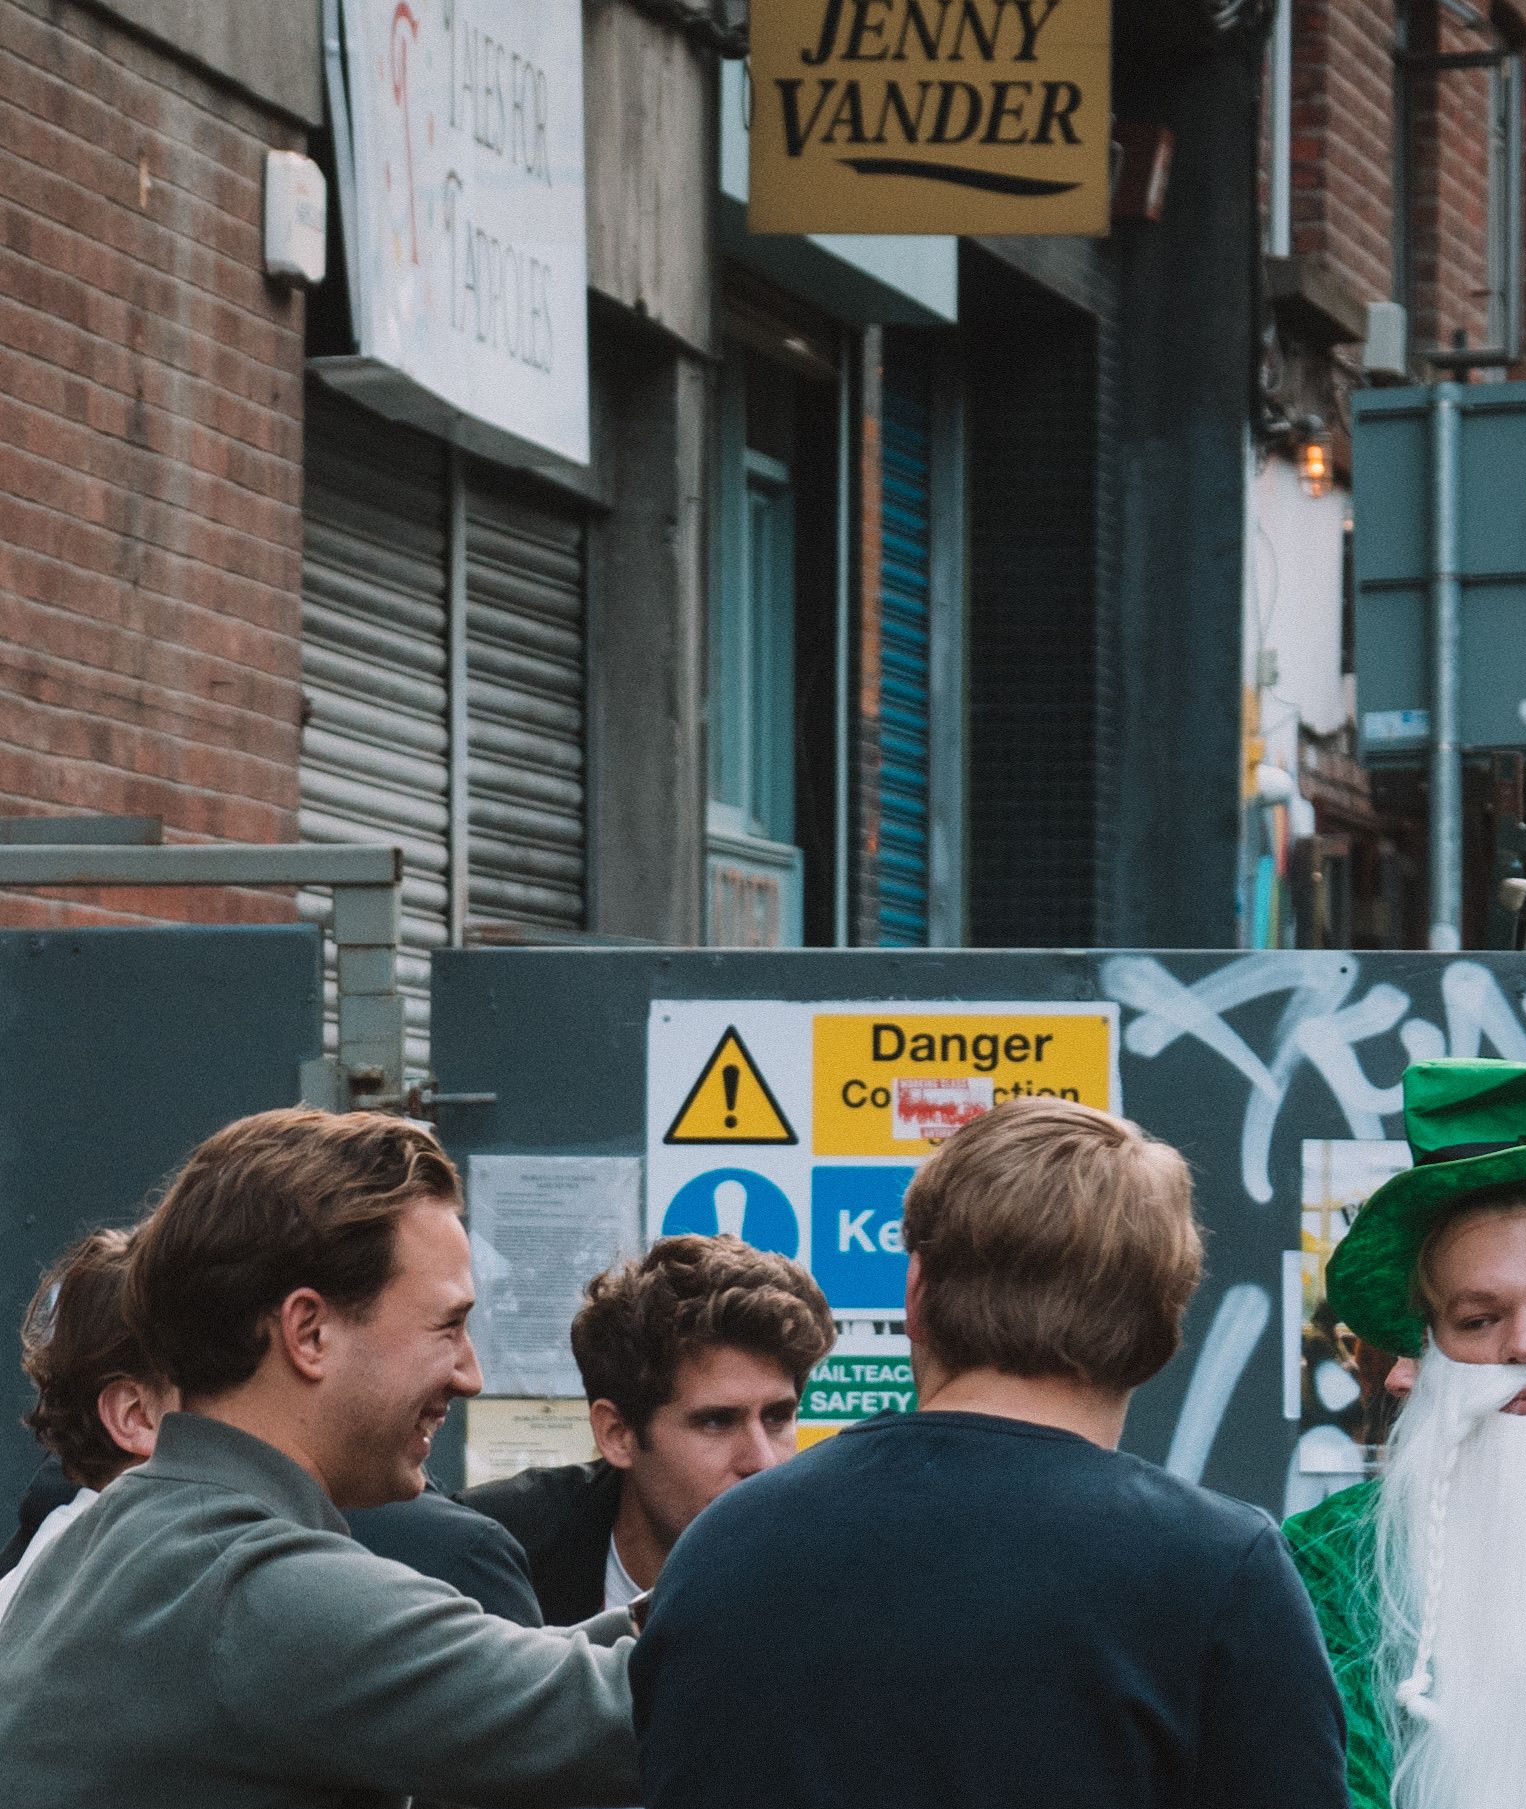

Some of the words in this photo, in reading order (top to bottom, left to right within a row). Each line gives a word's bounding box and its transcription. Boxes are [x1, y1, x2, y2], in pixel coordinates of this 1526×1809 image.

[510, 50, 552, 189] FOR
[774, 78, 1083, 158] VANDER
[872, 1023, 1052, 1071] Danger
[839, 1209, 906, 1253] Ke
[809, 1359, 912, 1383] ÁILTEAC
[810, 1390, 913, 1413] SAFETY
